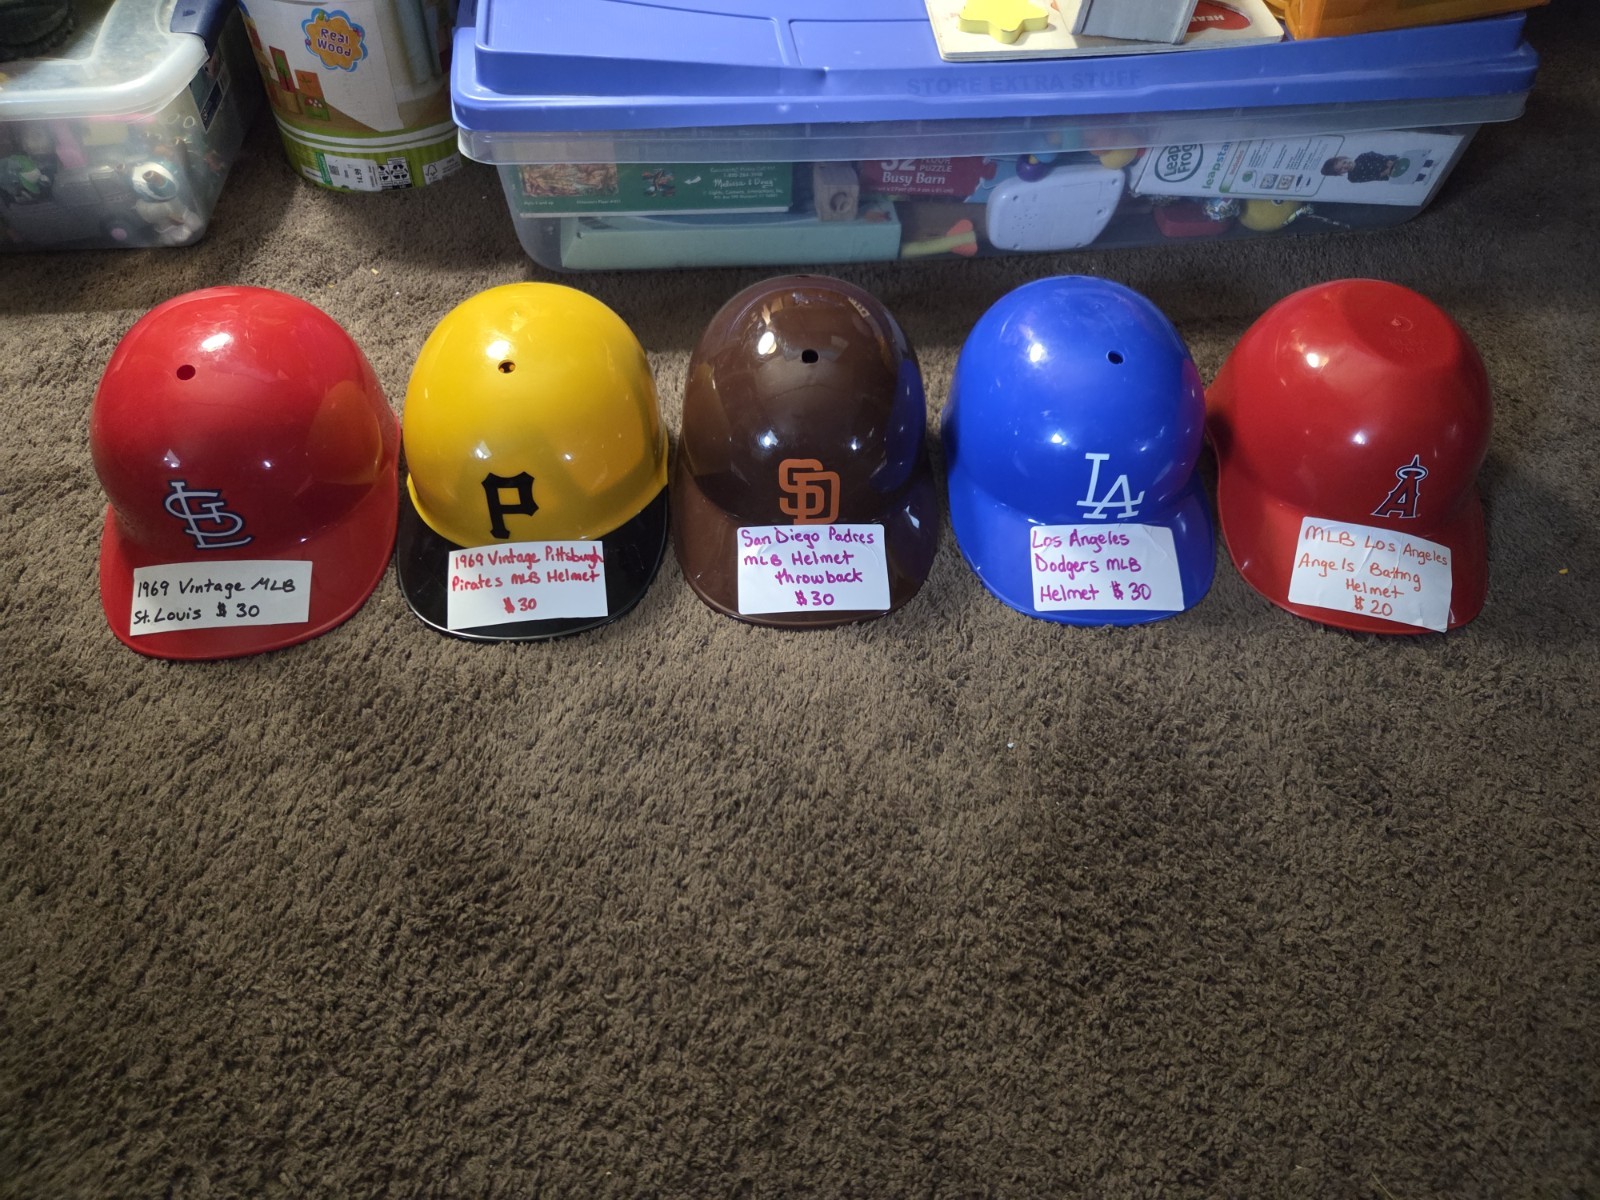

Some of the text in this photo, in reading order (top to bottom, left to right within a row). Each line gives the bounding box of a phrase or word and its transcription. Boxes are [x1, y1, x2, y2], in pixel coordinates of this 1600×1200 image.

[317, 39, 351, 57] Wood
[321, 28, 349, 44] Real
[906, 69, 1142, 95] STORE EXTRA STUFF
[919, 164, 953, 172] PUZZLE
[1163, 145, 1182, 177] Leap
[1177, 144, 1198, 174] Frog
[882, 171, 946, 187] Busy Barn
[778, 458, 841, 525] SD
[1076, 453, 1146, 520] LA
[1370, 454, 1429, 519] A
[481, 471, 539, 540] P
[741, 526, 876, 549] San Diego Padres
[1032, 528, 1130, 553] Los Angeles
[1305, 525, 1449, 566] MLB Los Angeles
[454, 545, 605, 571] 1969 Vintage Pittsburgh
[791, 550, 855, 566] Helmet
[1035, 553, 1100, 581] Dodgers
[1297, 552, 1355, 578] Angels
[137, 576, 296, 600] 1969 Vintage MLB
[452, 573, 504, 592] Pirates
[546, 568, 601, 584] Helmet
[1345, 577, 1405, 599] Helmet
[1040, 583, 1100, 603] Helmet
[133, 609, 151, 625] St.
[154, 607, 202, 623] Louis
